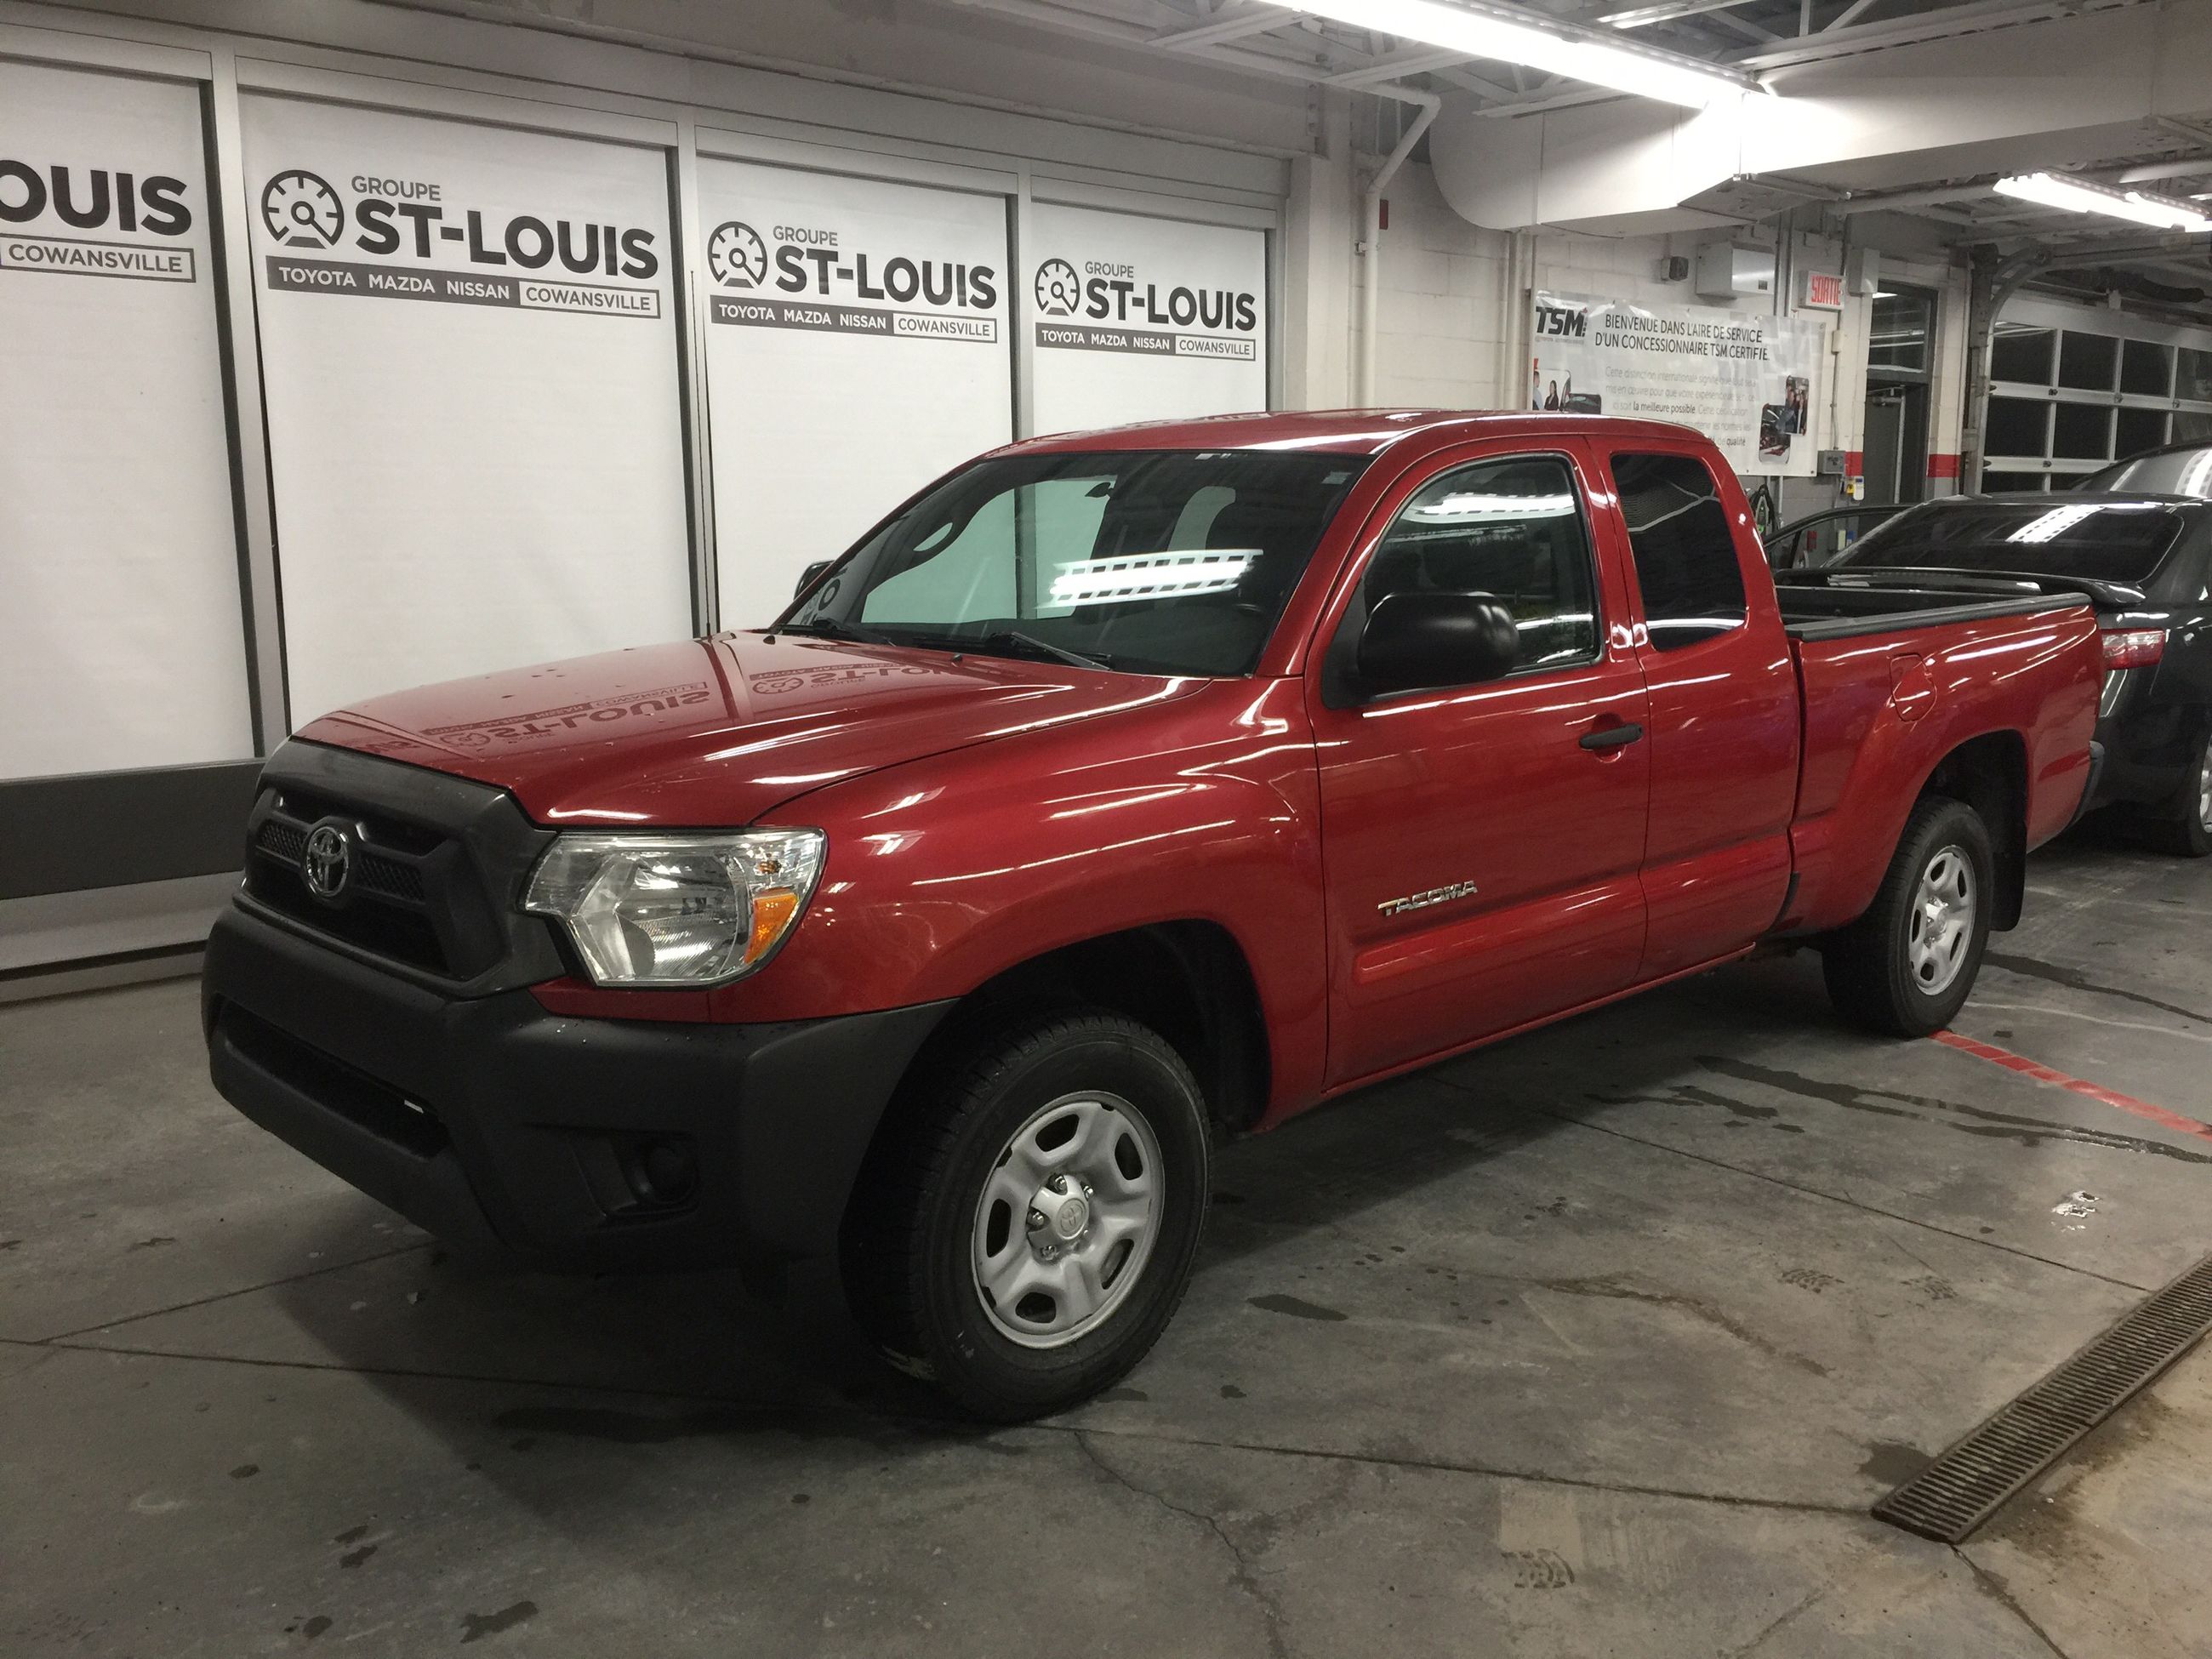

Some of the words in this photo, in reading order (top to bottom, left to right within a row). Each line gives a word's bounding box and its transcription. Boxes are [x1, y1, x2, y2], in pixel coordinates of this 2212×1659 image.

[351, 175, 442, 201] GROUPE
[356, 198, 658, 279] ST-LOUIS
[772, 225, 838, 246] GROUPE
[9, 244, 182, 272] COWANSVILLE
[1085, 261, 1134, 278] GROUPE
[279, 266, 356, 288] TOYOTA
[368, 274, 436, 294] MAZDA
[447, 280, 510, 299] NISSAN
[526, 287, 651, 311] COWANSVILLE
[776, 245, 996, 310] ST-LOUIS
[1810, 275, 1842, 306] SORTIE
[1086, 277, 1257, 332] ST-LOUIS
[719, 304, 776, 321] TOYOTA
[784, 309, 832, 325] MAZDA
[840, 313, 887, 329] NISSAN
[898, 317, 990, 336] COWANSVILLE
[1536, 306, 1585, 337] TSM
[1605, 314, 1658, 333] BIENVENUE
[1661, 319, 1685, 336] DANS
[1687, 322, 1712, 339] L'AIRE
[1713, 325, 1725, 339] DE
[1726, 327, 1763, 343] SERVICE
[1041, 330, 1085, 344] TOYOTA
[1091, 334, 1128, 347] MAZDA
[1132, 336, 1170, 350] NISSAN
[1179, 339, 1251, 355] COWANSVILLE
[1595, 332, 1619, 348] D'UN
[1621, 334, 1708, 356] CONCESSIONNAIRE
[1710, 343, 1728, 357] TSM
[1633, 401, 1639, 411] la
[1640, 402, 1670, 413] meilleure
[1377, 880, 1478, 916] TACOMA
